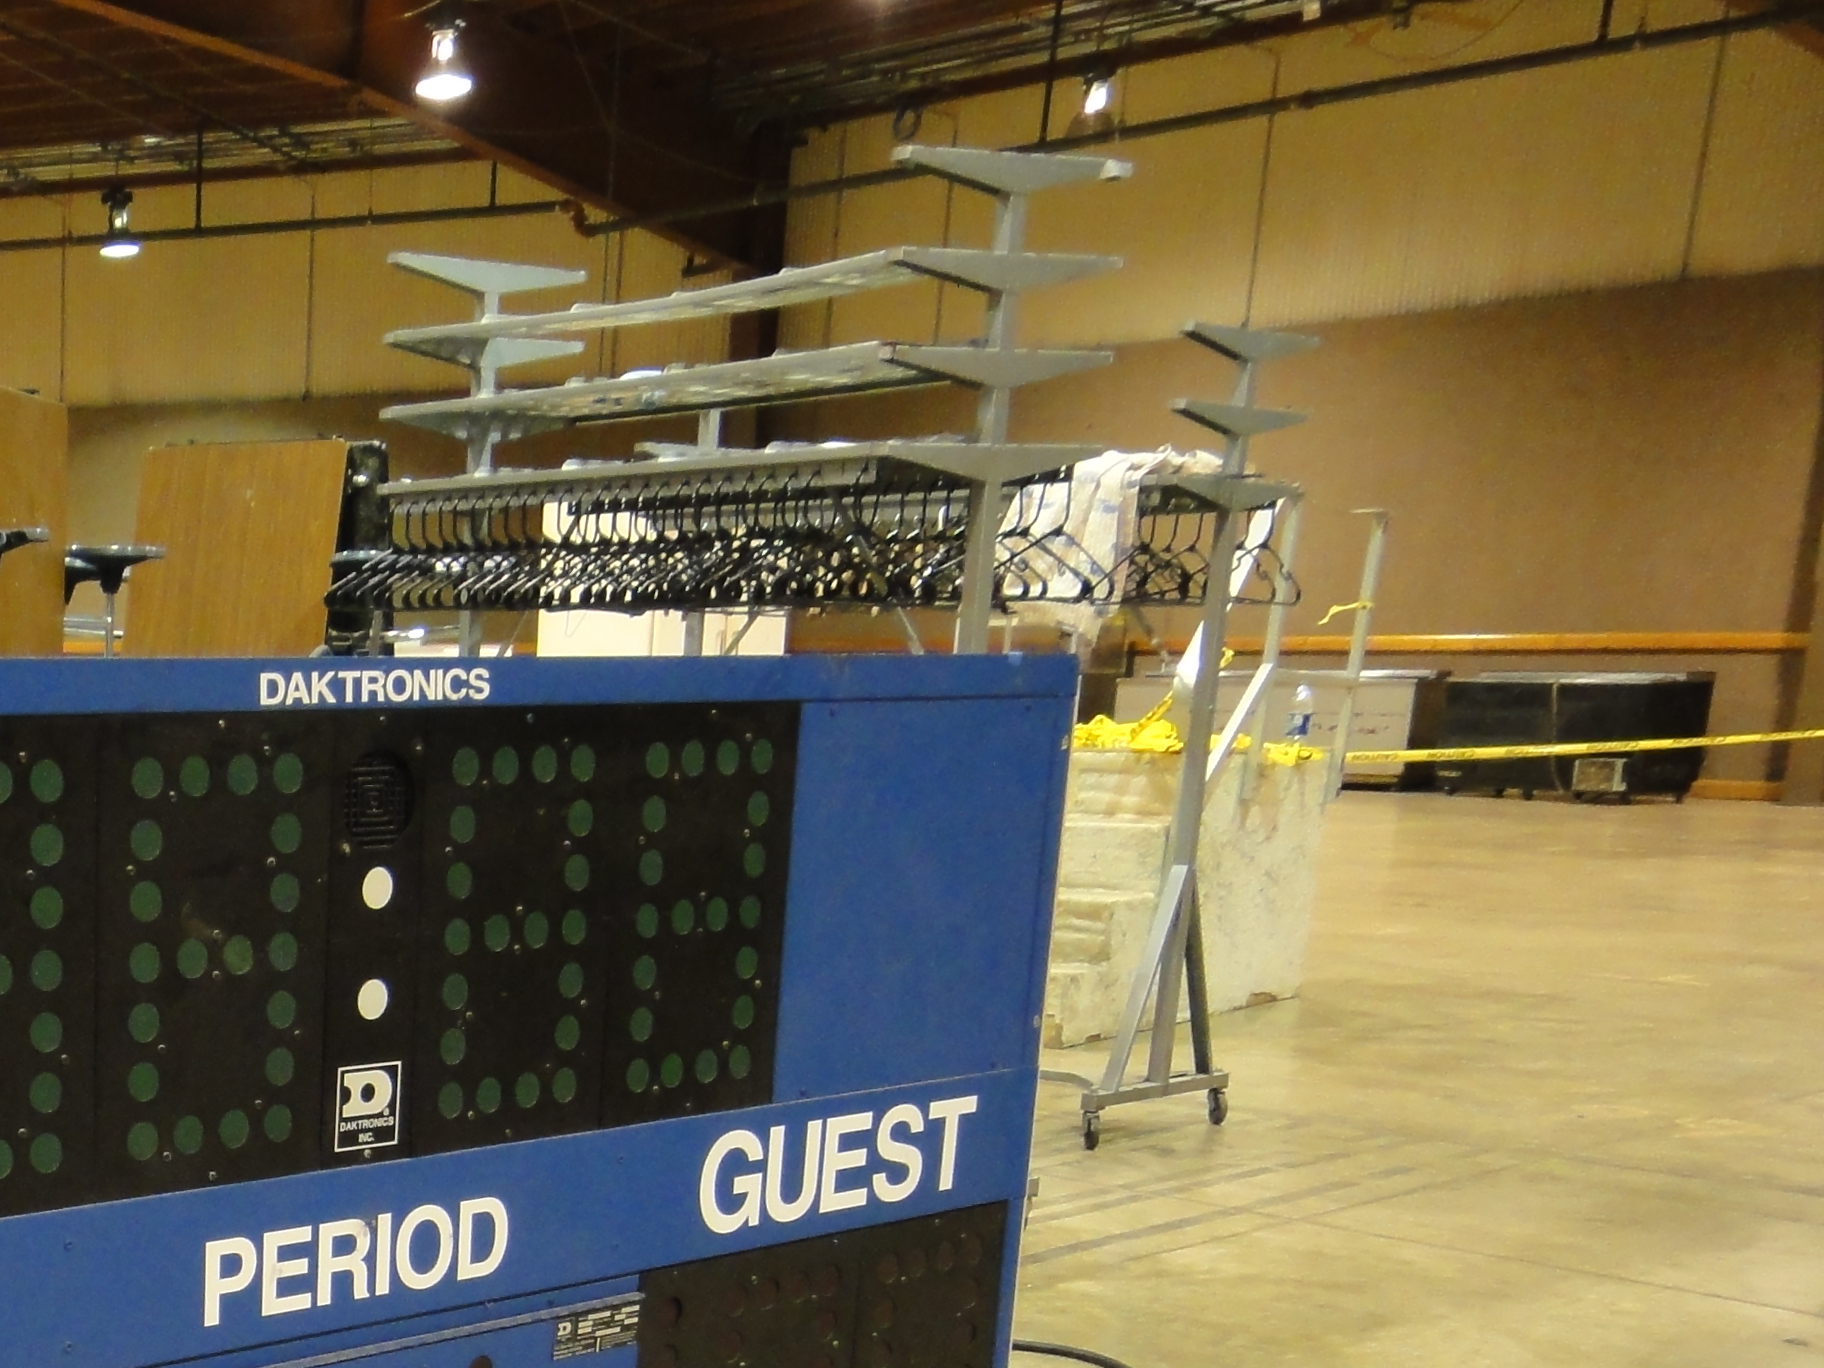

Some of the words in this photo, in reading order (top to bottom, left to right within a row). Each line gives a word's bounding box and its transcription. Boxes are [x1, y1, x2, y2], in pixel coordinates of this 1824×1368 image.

[259, 667, 491, 706] DAKTRONICS
[339, 1115, 395, 1133] DAKTRONICS
[358, 1131, 375, 1143] INC.
[699, 1095, 979, 1235] GUEST
[203, 1196, 509, 1328] PERIOD
